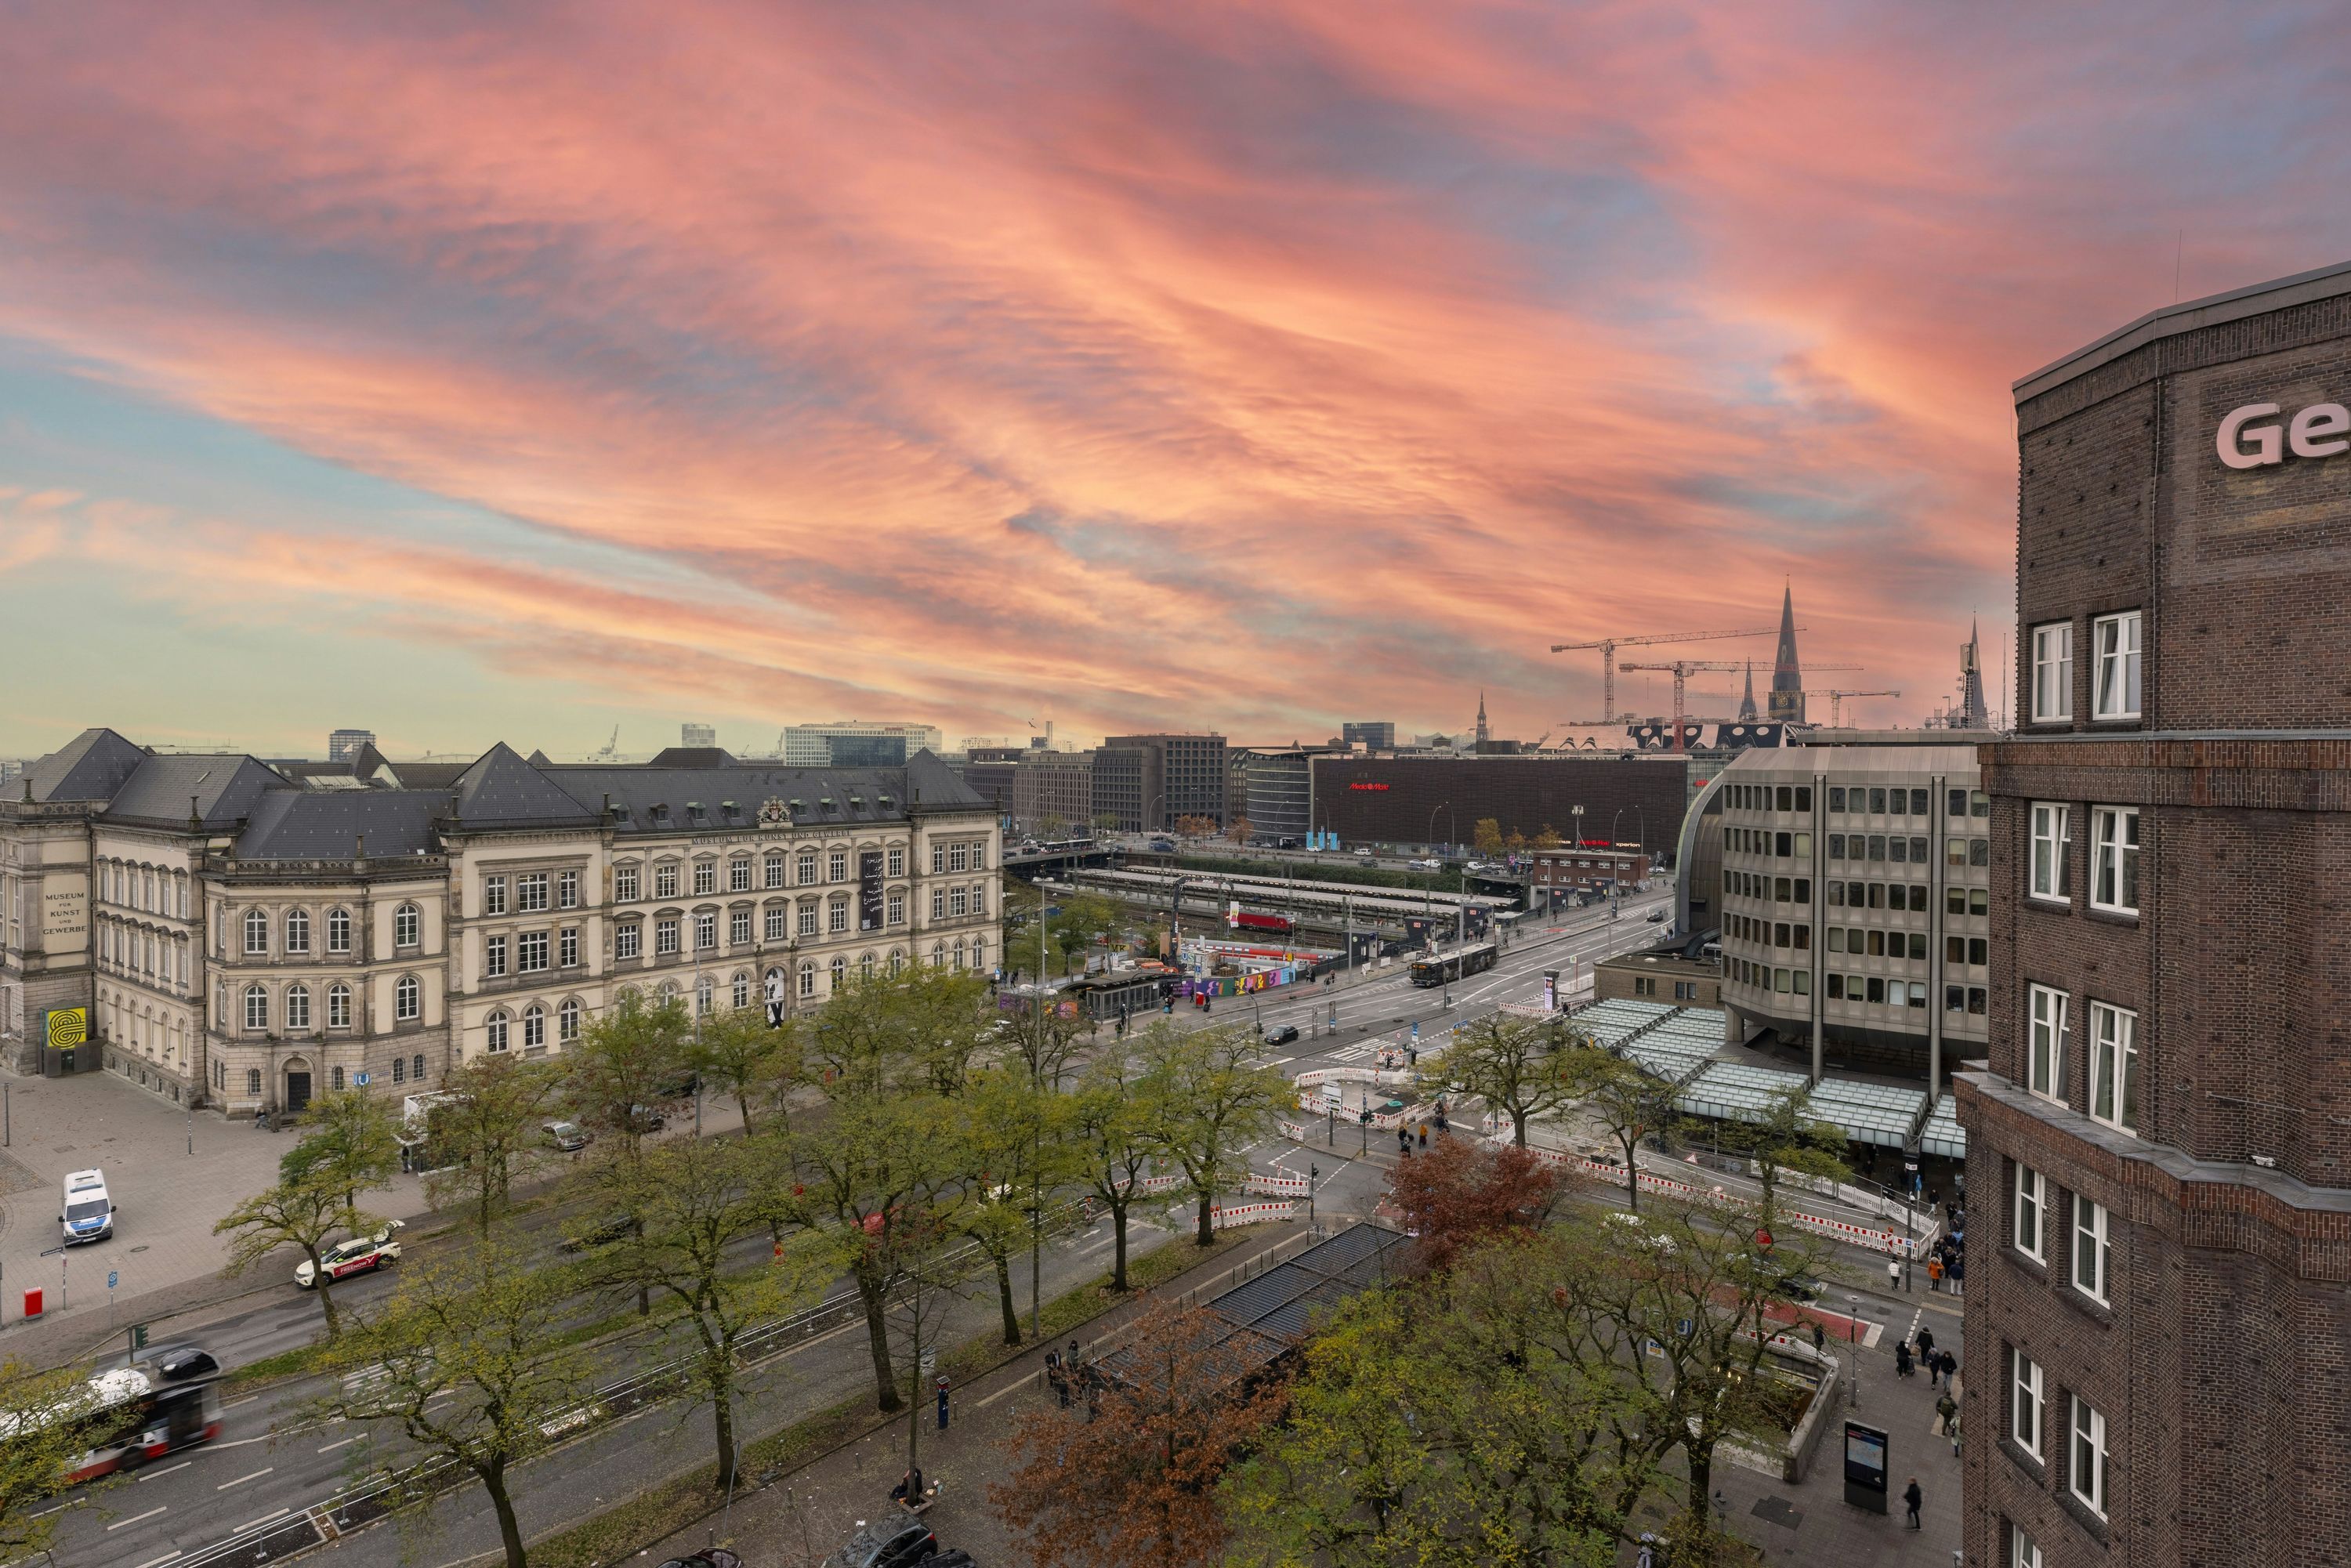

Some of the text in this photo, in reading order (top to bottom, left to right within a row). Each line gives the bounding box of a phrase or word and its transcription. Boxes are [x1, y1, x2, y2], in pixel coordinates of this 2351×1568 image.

[2216, 403, 2351, 469] Ge
[693, 836, 733, 845] MUSEUM
[43, 925, 86, 935] GEWERBE
[1324, 1047, 1374, 1062] TAXI
